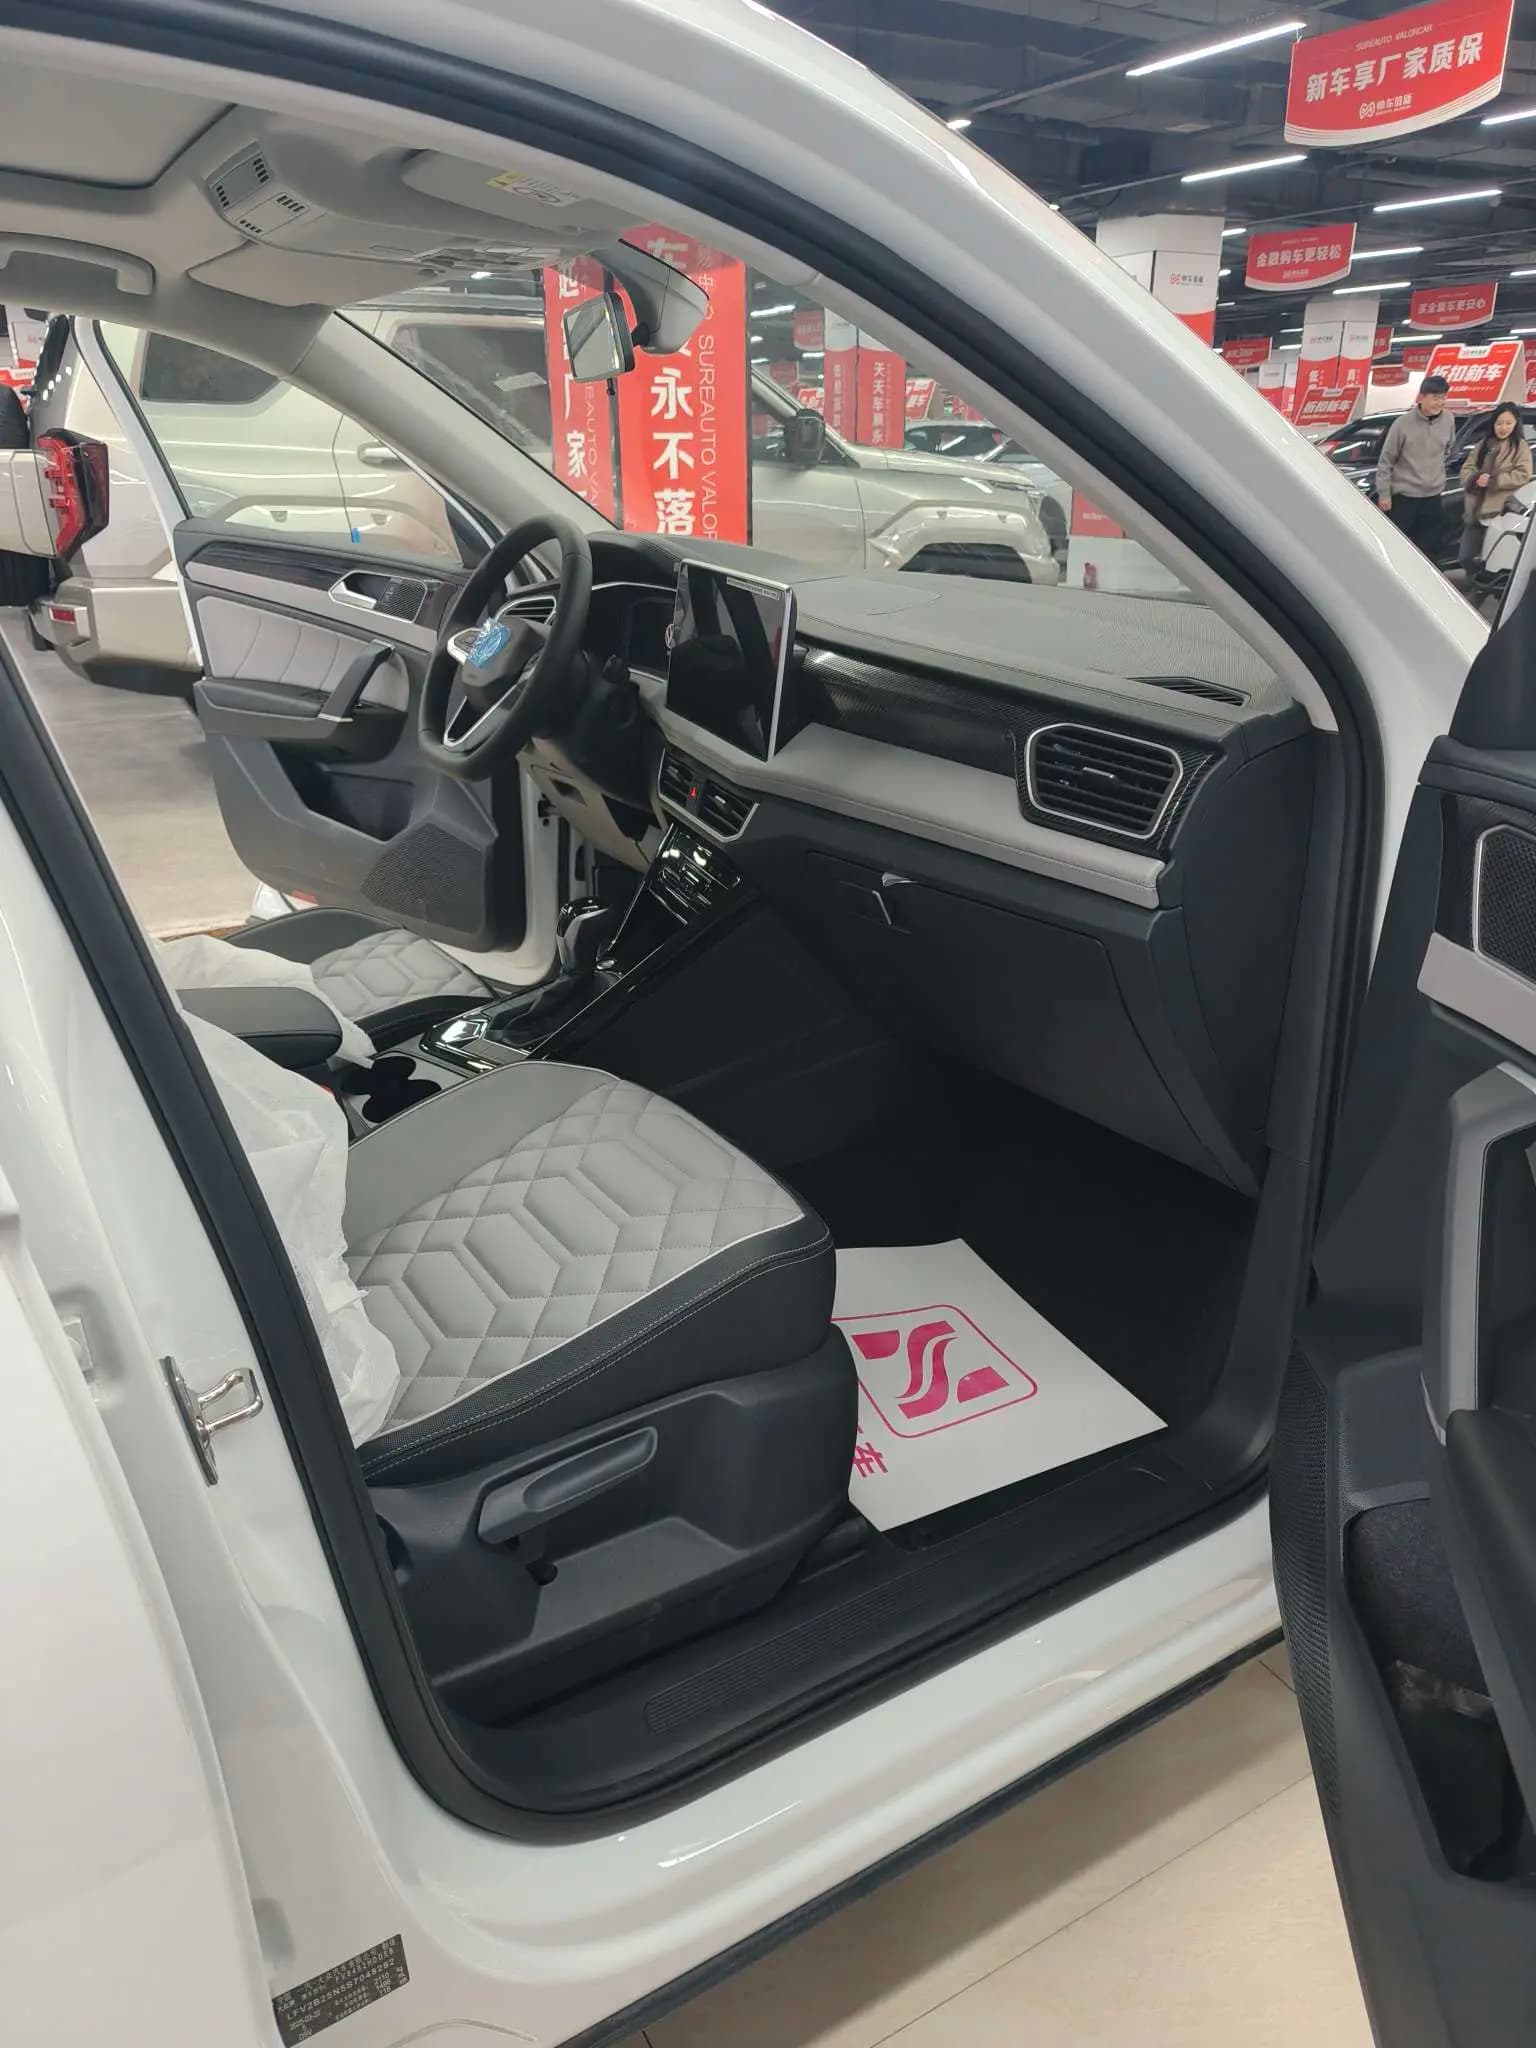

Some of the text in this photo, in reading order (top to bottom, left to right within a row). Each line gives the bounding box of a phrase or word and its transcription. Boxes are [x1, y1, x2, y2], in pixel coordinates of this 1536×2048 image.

[1305, 32, 1484, 103] 新车享厂家质保
[1256, 244, 1342, 268] 金融购车更轻松
[1431, 364, 1506, 383] 折扣新车
[699, 335, 717, 466] SUREAUTO
